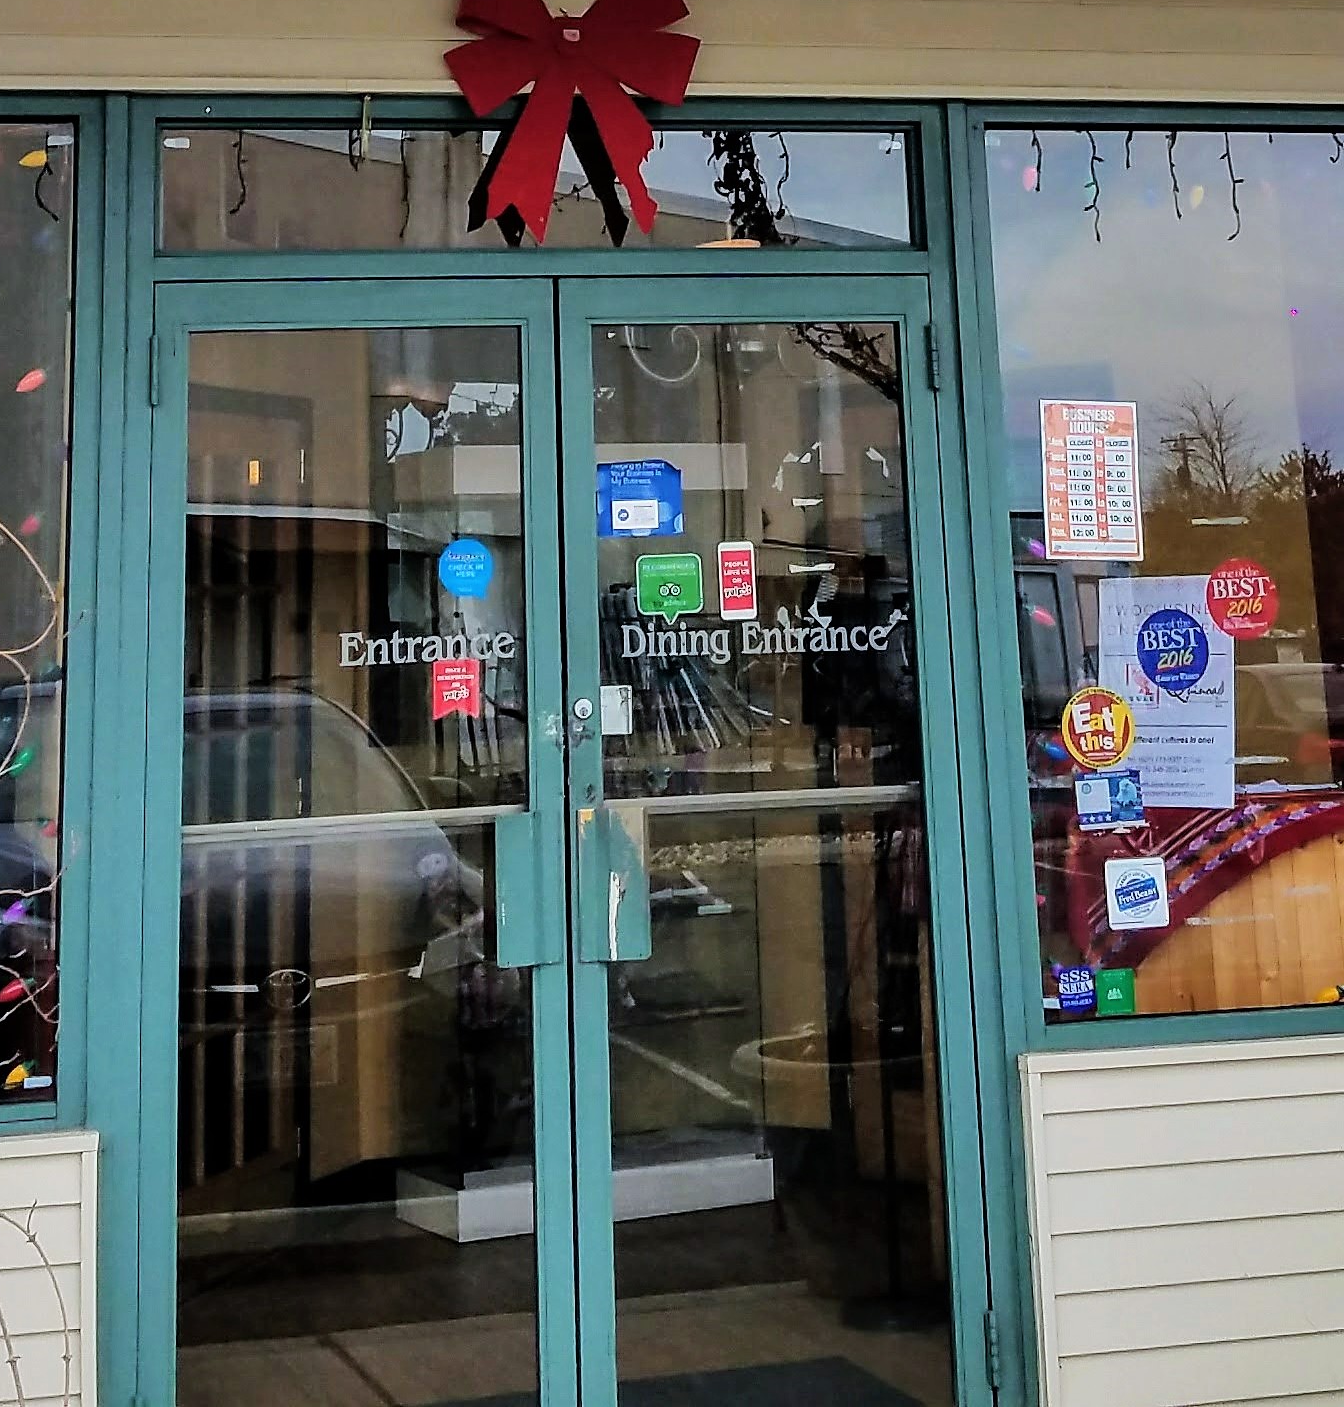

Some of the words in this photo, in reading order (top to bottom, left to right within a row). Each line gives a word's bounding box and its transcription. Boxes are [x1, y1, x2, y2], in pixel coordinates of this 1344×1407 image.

[1063, 409, 1115, 422] BUSINESS
[724, 560, 749, 568] PEOPLE
[1212, 576, 1270, 600] BEST
[1226, 596, 1263, 618] 2016
[339, 630, 515, 668] Entrance
[621, 622, 730, 663] Dining
[740, 622, 888, 657] Entrance
[1141, 627, 1201, 651] BEST
[1157, 647, 1194, 670] 2016
[1072, 701, 1116, 734] Eat
